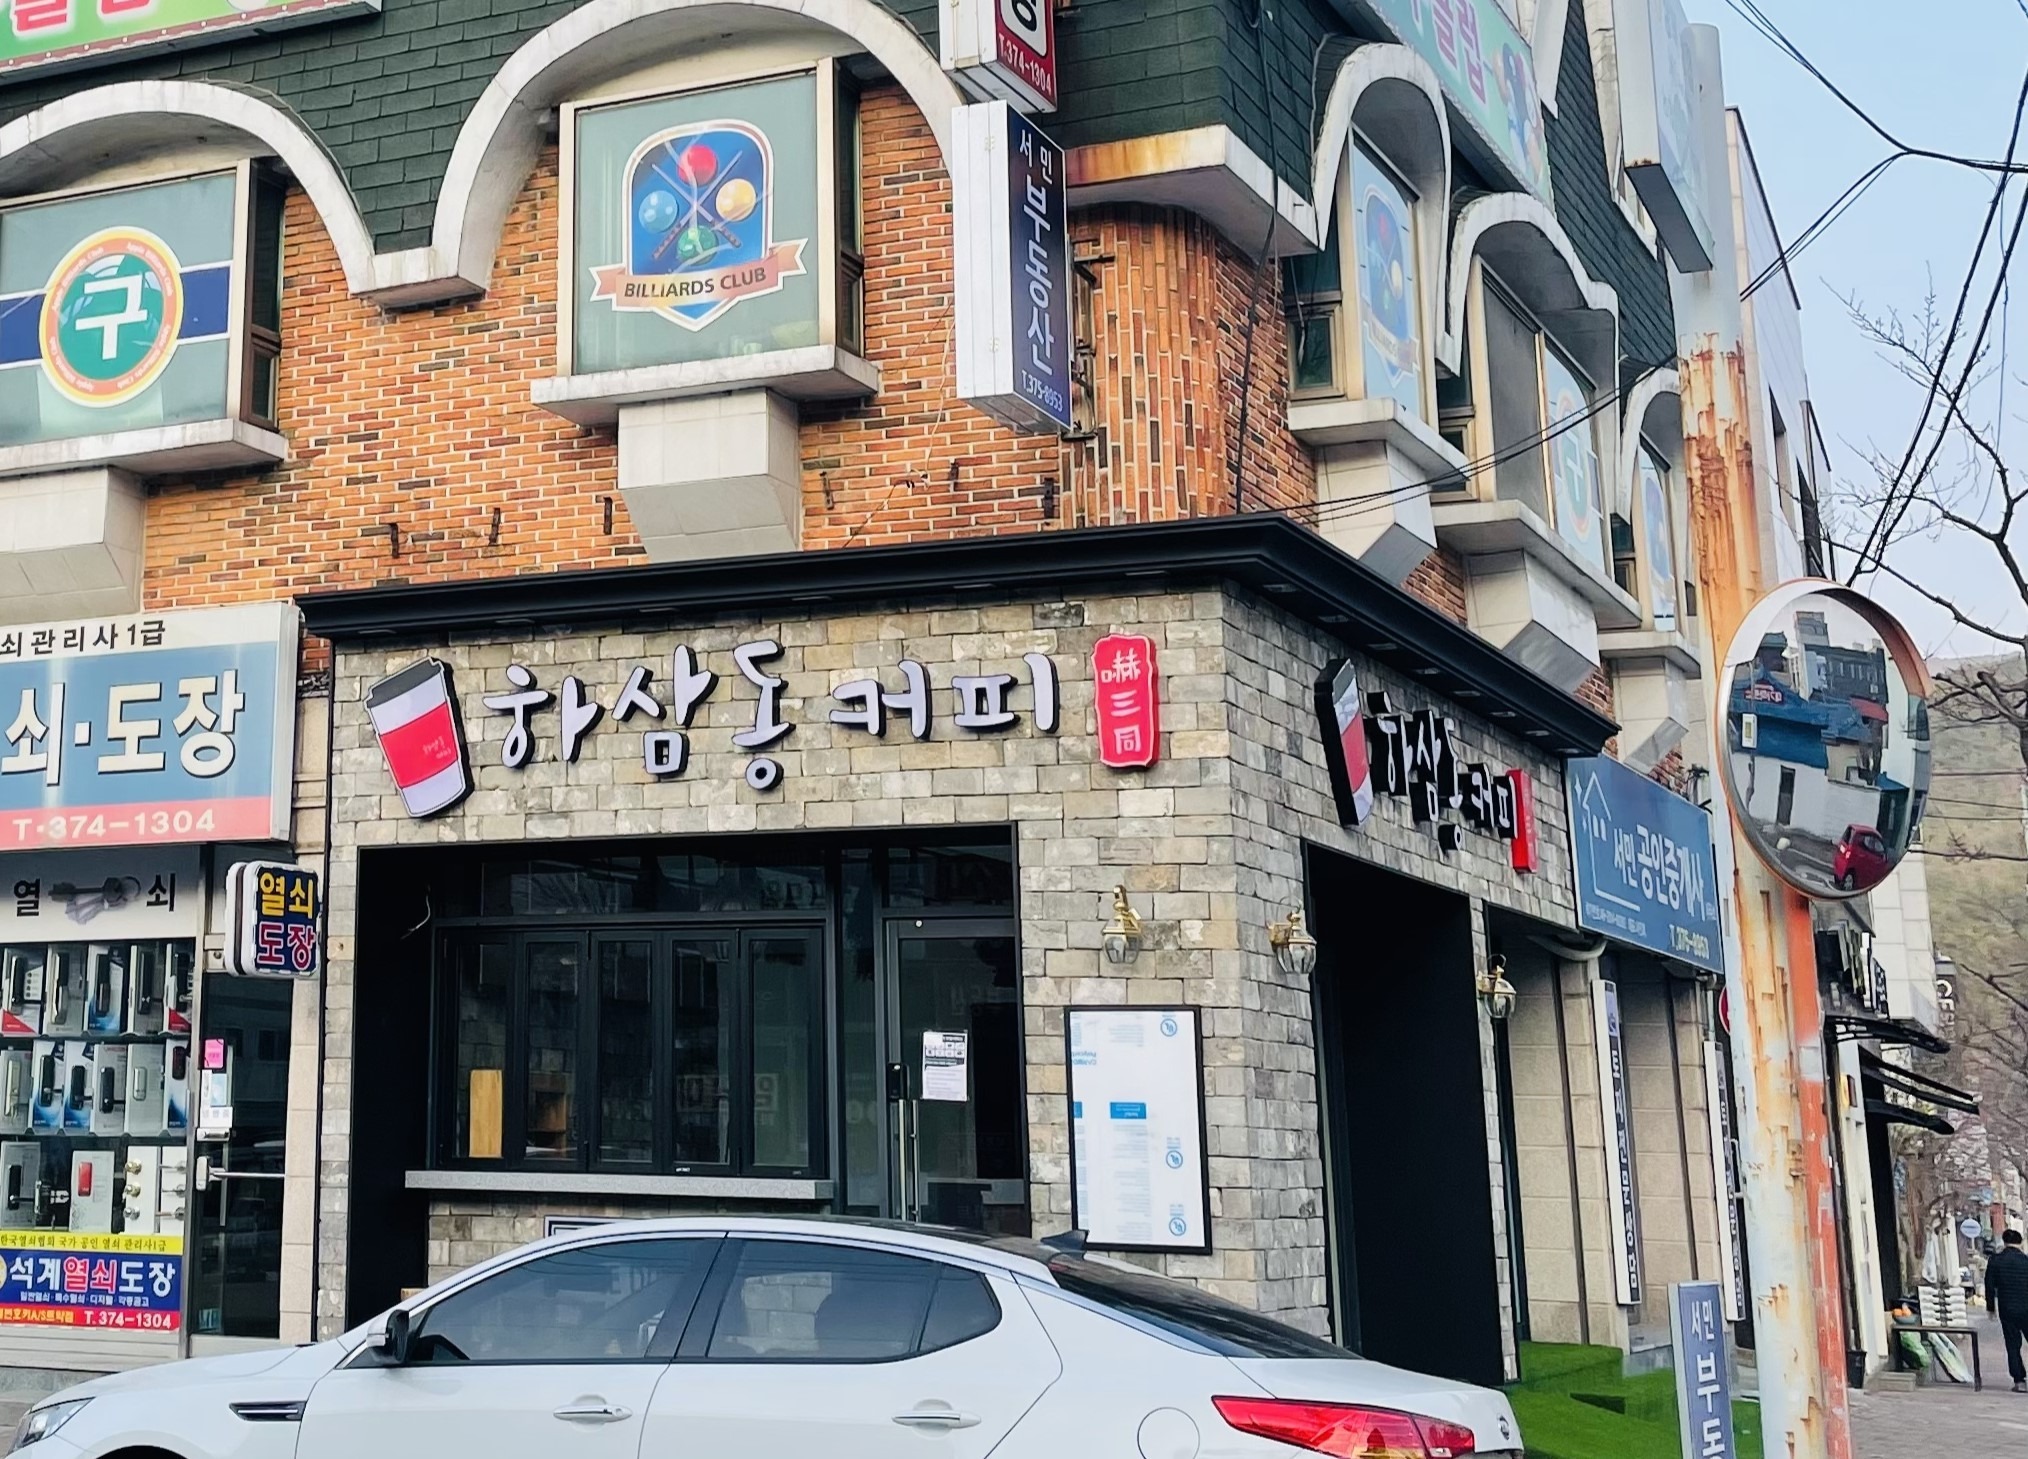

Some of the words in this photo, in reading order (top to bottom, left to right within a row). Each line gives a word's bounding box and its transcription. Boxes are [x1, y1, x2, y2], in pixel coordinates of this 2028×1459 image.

[1020, 129, 1053, 185] 서민
[624, 278, 715, 298] BILLIARDS
[720, 266, 767, 290] CLUB
[1023, 174, 1055, 376] 부동산
[75, 273, 148, 361] 구
[14, 878, 41, 917] 열
[146, 872, 176, 913] 쇠
[260, 872, 314, 919] 열쇠
[257, 921, 316, 970] 도장
[9, 1256, 176, 1297] 석계열쇠도장
[1690, 1298, 1716, 1342] 서민
